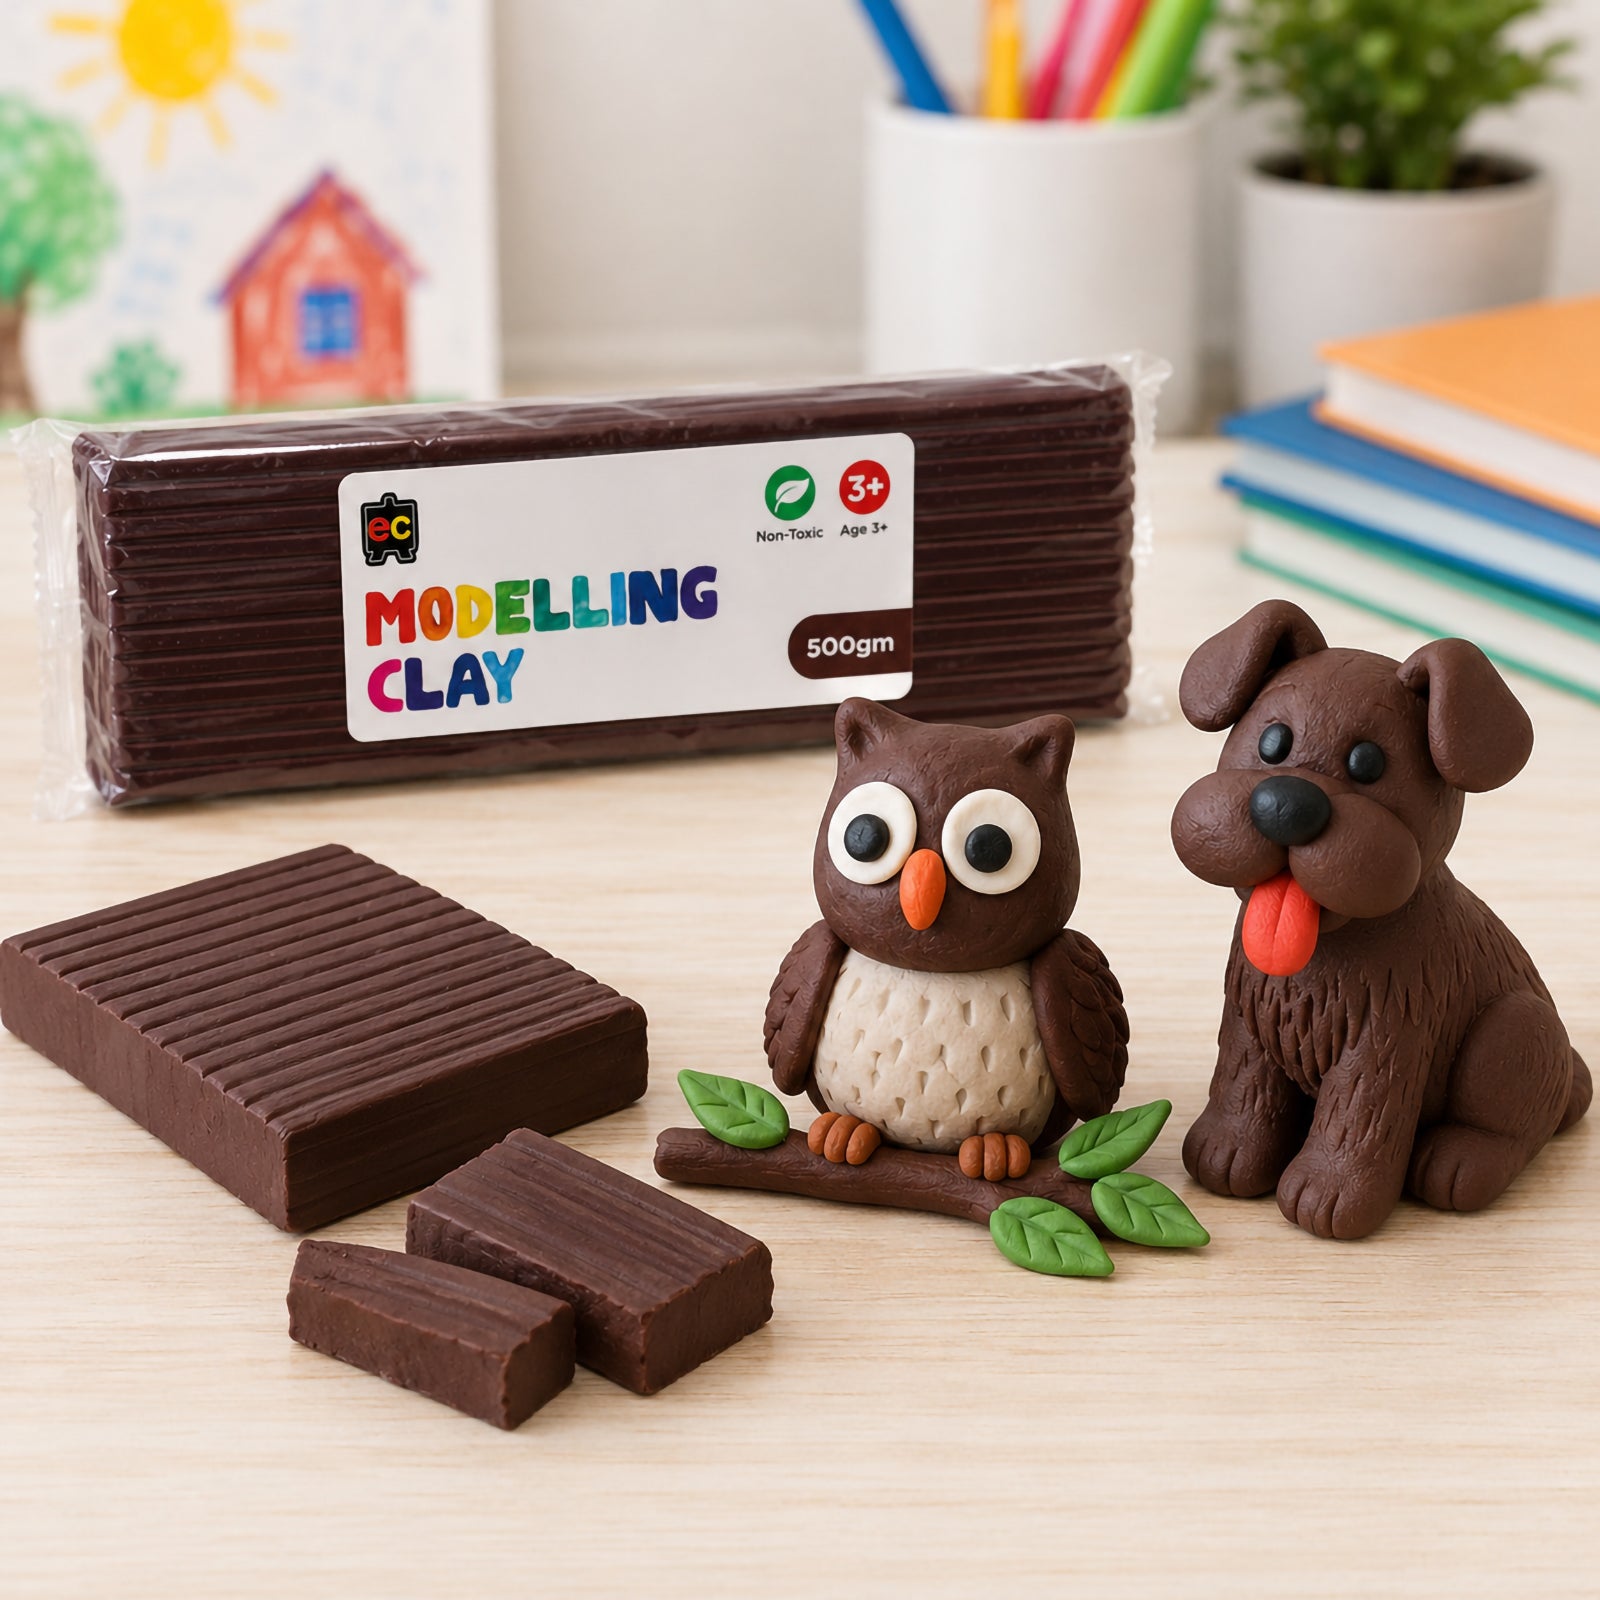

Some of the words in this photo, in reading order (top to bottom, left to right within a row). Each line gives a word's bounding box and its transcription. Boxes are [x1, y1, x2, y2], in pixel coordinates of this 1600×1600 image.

[848, 474, 884, 503] 3+
[368, 515, 411, 542] ec
[756, 526, 824, 543] Non-Toxic
[840, 524, 867, 538] Age
[871, 522, 888, 534] 3+
[366, 565, 719, 647] MODELLING
[806, 634, 895, 660] 500gm
[367, 647, 525, 713] CLAY
